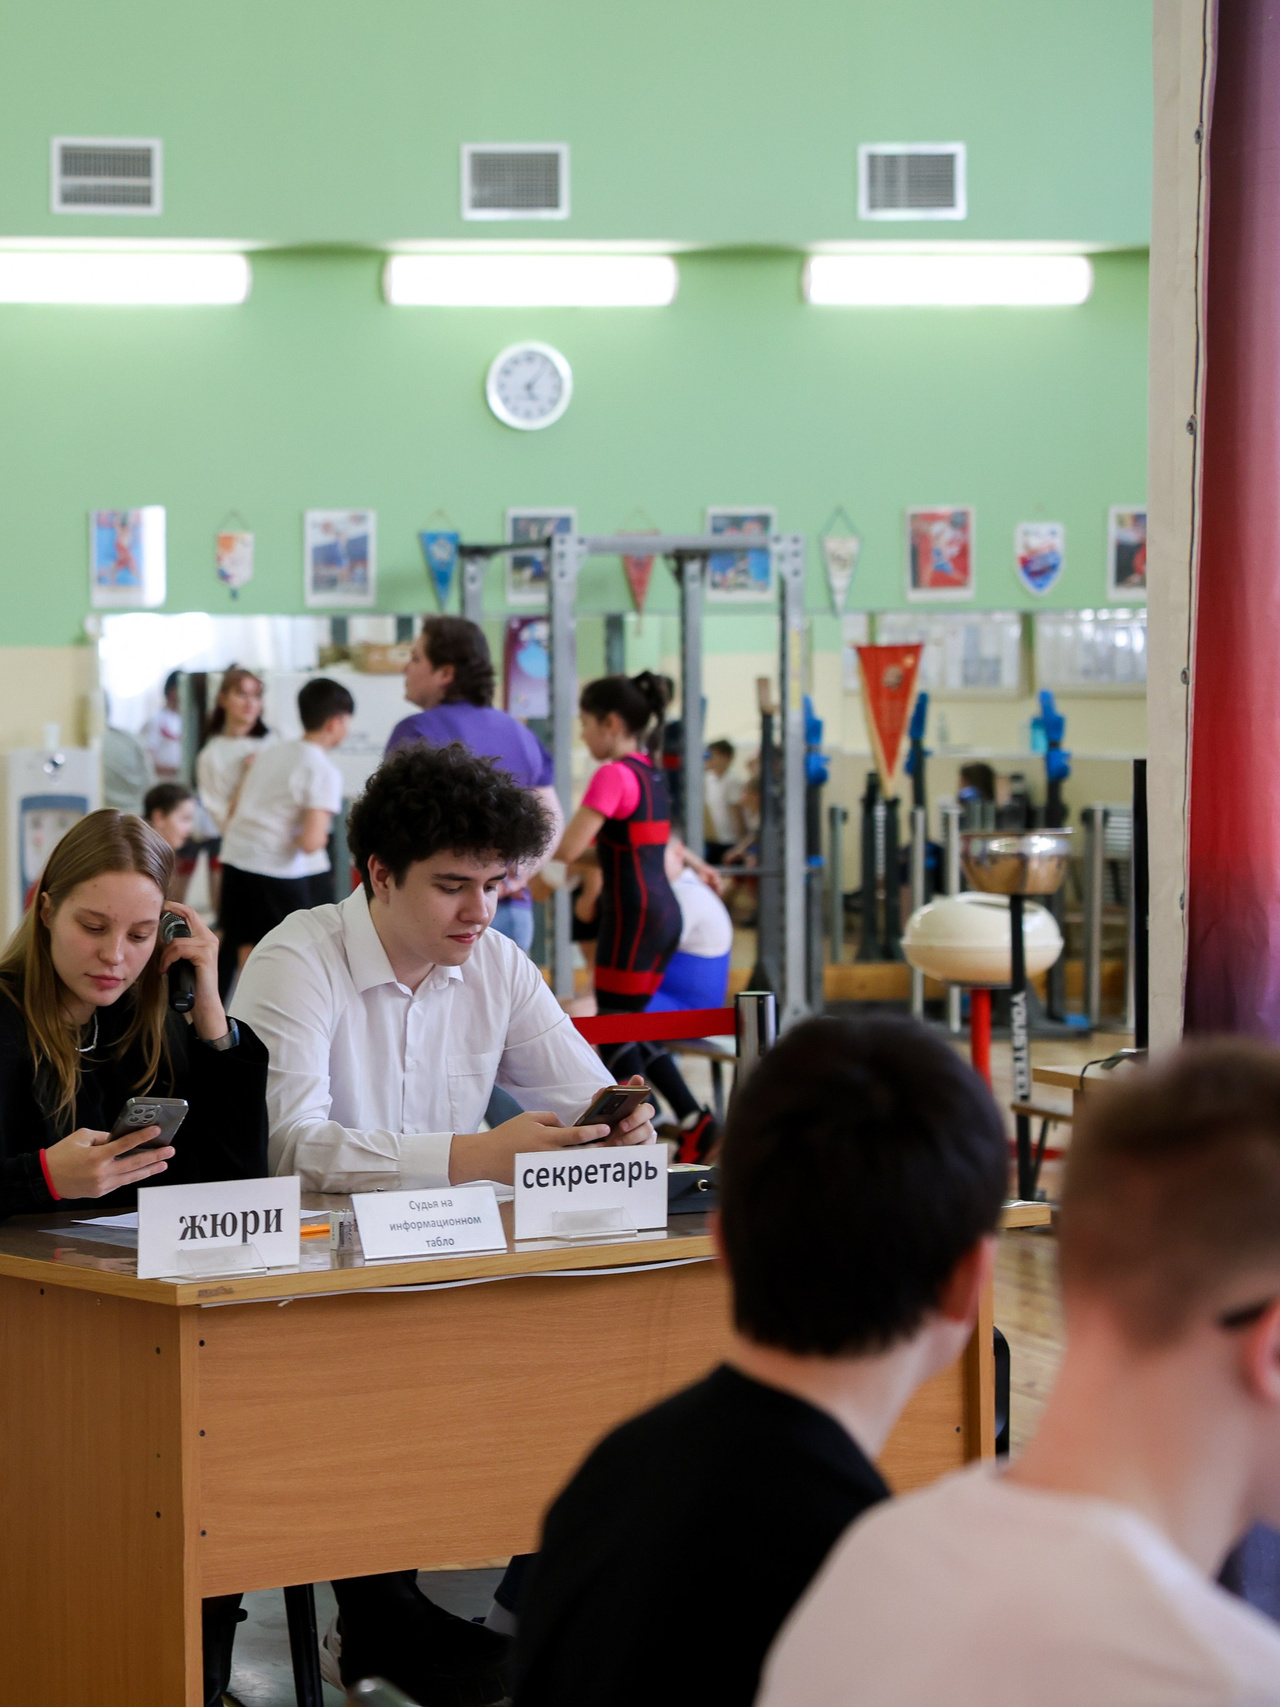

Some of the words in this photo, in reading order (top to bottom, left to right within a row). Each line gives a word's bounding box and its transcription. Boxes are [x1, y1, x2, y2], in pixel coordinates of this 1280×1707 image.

[522, 1159, 658, 1193] секретарь
[408, 1200, 439, 1212] Судья
[440, 1199, 454, 1208] на
[178, 1208, 284, 1244] жюри
[389, 1215, 482, 1232] информационном
[425, 1236, 455, 1248] табло
